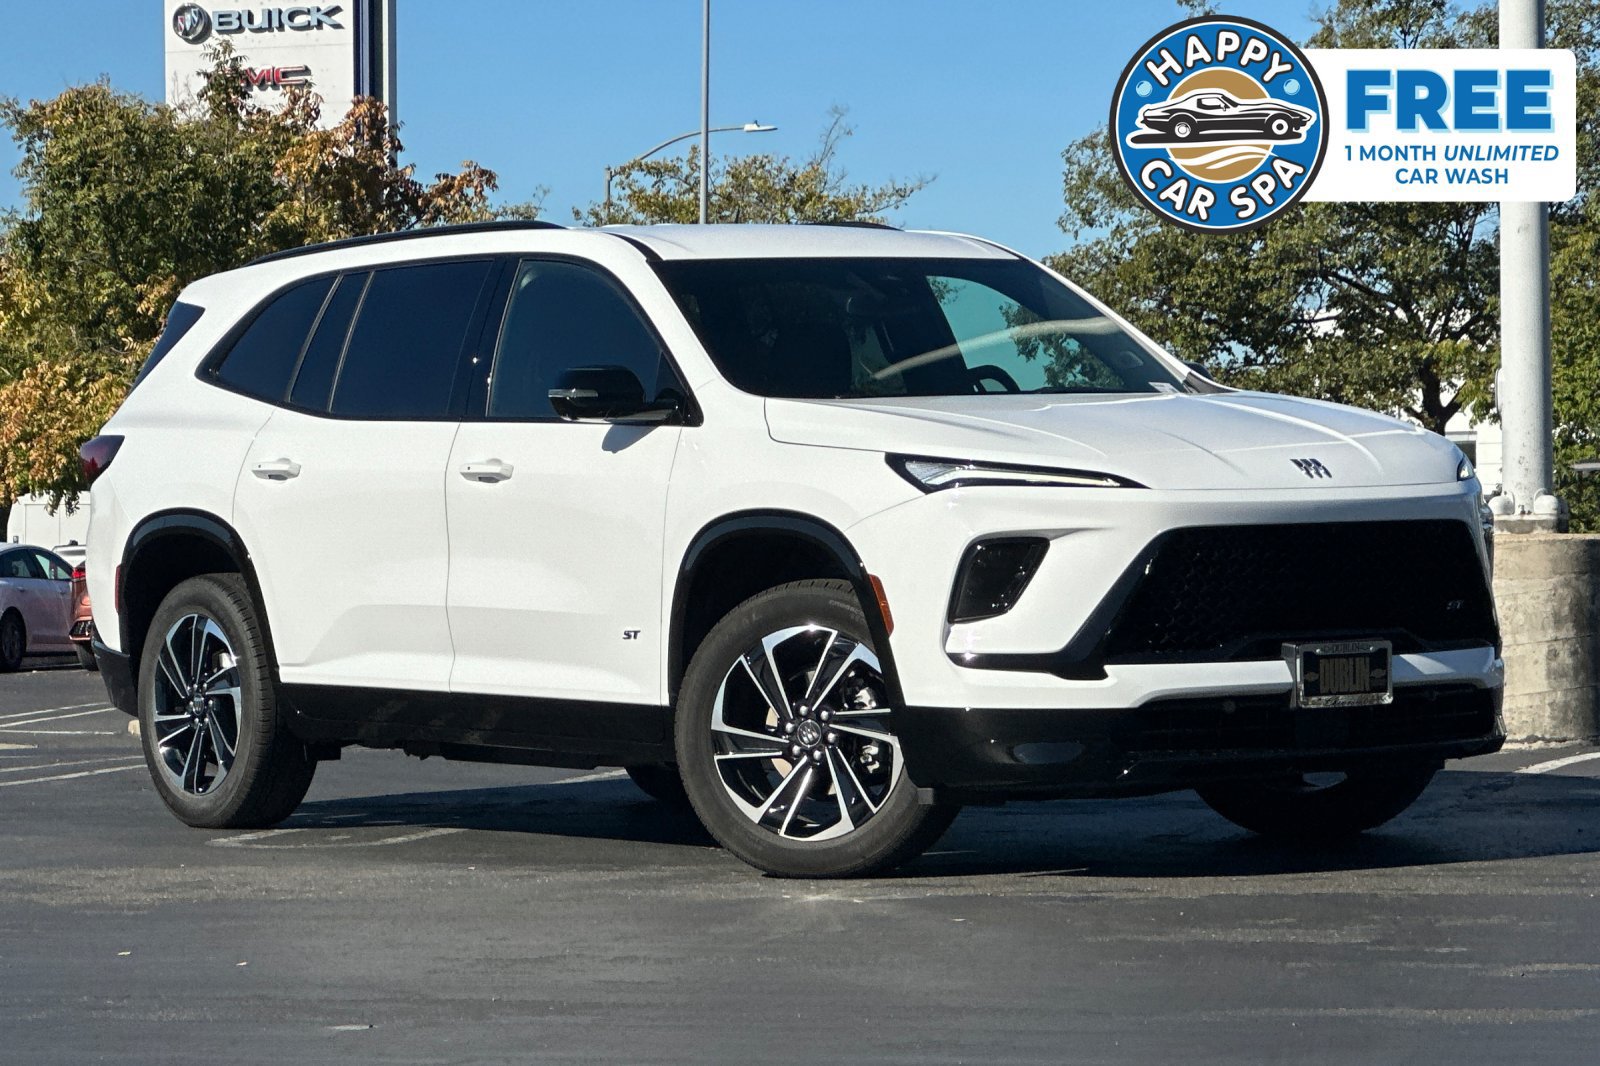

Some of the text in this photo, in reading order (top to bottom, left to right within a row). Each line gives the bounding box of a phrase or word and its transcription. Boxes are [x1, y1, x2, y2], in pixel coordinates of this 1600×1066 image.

[212, 5, 344, 32] BUICK
[238, 64, 311, 89] MC
[622, 630, 641, 640] ST
